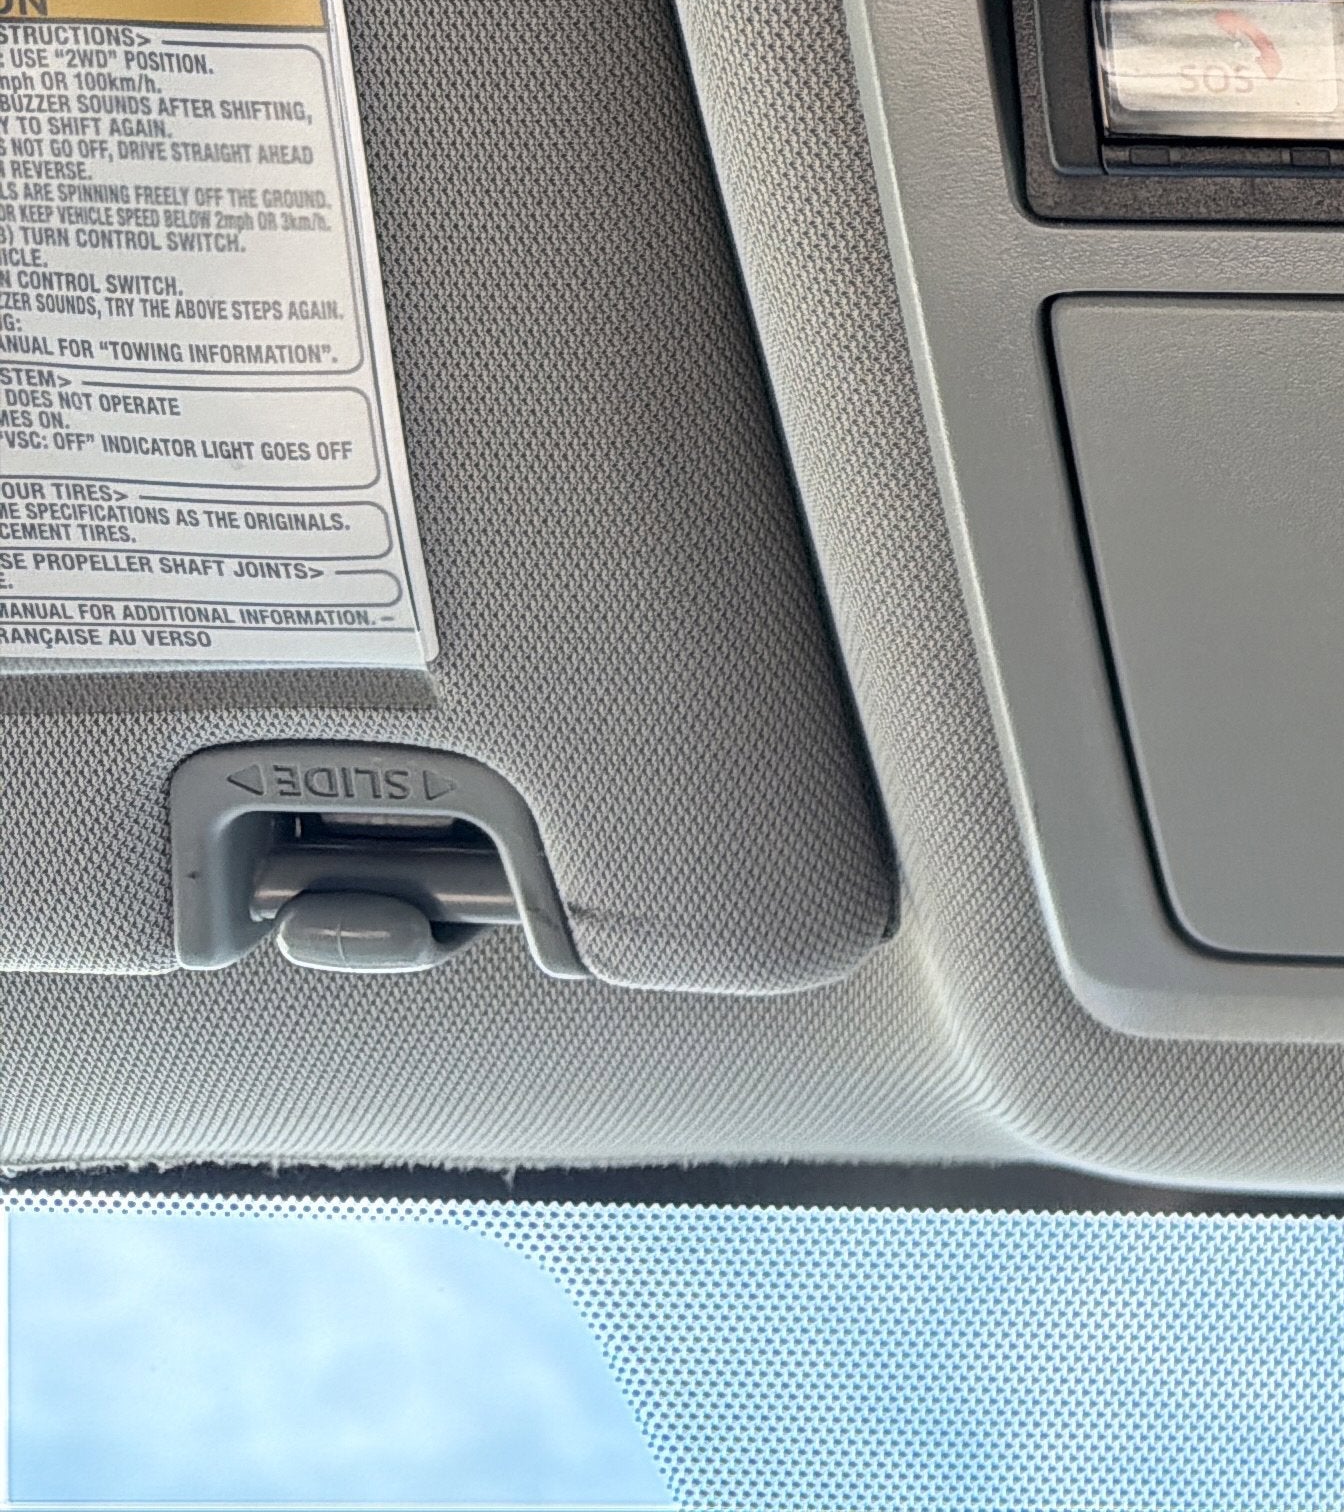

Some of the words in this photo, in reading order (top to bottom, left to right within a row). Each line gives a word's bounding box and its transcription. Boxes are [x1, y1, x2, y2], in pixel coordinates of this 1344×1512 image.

[11, 49, 47, 68] USE
[125, 51, 214, 74] POSITION.
[41, 72, 68, 90] OR
[75, 72, 162, 94] 100km/h.
[1179, 64, 1253, 93] SOS
[0, 94, 70, 113] BUZZER
[77, 96, 151, 116] SOUNDS
[158, 99, 214, 120] AFTER
[221, 101, 312, 124] SHIFTING,
[16, 116, 42, 135] TO
[48, 117, 101, 136] SHIFT
[109, 119, 172, 138] AGAIN.
[12, 139, 44, 157] NOT
[50, 140, 73, 158] GO
[79, 141, 113, 163] OFF,
[118, 141, 165, 161] DRIVE
[171, 143, 250, 163] STRAIGHT
[257, 145, 313, 164] AHEAD
[10, 161, 92, 180] REVERSE.
[24, 184, 54, 202] ARE
[57, 184, 130, 204] SPINNING
[135, 186, 188, 206] FREELY
[195, 187, 223, 207] OFF
[227, 189, 258, 208] THE
[262, 190, 332, 209] GROUND.
[20, 206, 53, 224] KEEP
[57, 207, 113, 226] VEHICLE
[117, 208, 160, 227] SPEED
[164, 210, 210, 229] BELOW
[215, 211, 253, 233] 2mph
[257, 212, 281, 230] OR
[281, 213, 331, 232] 3km/h.
[19, 227, 69, 248] TURN
[76, 229, 161, 250] CONTROL
[166, 232, 246, 253] SWITCH.
[0, 249, 48, 268] ICLE.
[17, 271, 100, 293] CONTROL
[106, 274, 183, 296] SWITCH.
[36, 296, 101, 320] SOUNDS,
[105, 298, 137, 317] TRY
[142, 298, 170, 318] THE
[175, 299, 228, 320] ABOVE
[232, 300, 282, 321] STEPS
[288, 300, 344, 321] AGAIN.
[0, 316, 23, 331] G:
[58, 338, 94, 358] FOR
[5, 391, 53, 409] DOES
[58, 392, 93, 411] NOT
[100, 395, 181, 416] OPERATE
[38, 412, 70, 430] ON.
[102, 435, 197, 457] INDICATOR
[202, 439, 255, 460] LIGHT
[261, 441, 311, 461] GOES
[316, 441, 353, 460] OFF
[1, 482, 45, 499] OUR
[26, 503, 168, 526] SPECIFICATIONS
[176, 510, 199, 527] AS
[204, 511, 240, 529] THE
[244, 512, 350, 531] ORIGINALS.
[0, 523, 72, 541] CEMENT
[77, 525, 137, 543] TIRES.
[0, 553, 27, 570] SE
[33, 555, 153, 573] PROPELLER
[160, 558, 225, 577] SHAFT
[78, 604, 115, 621] FOR
[123, 605, 236, 624] ADDITIONAL
[109, 628, 138, 646] AU
[143, 630, 212, 648] VERSO
[274, 765, 409, 799] SLIDE
